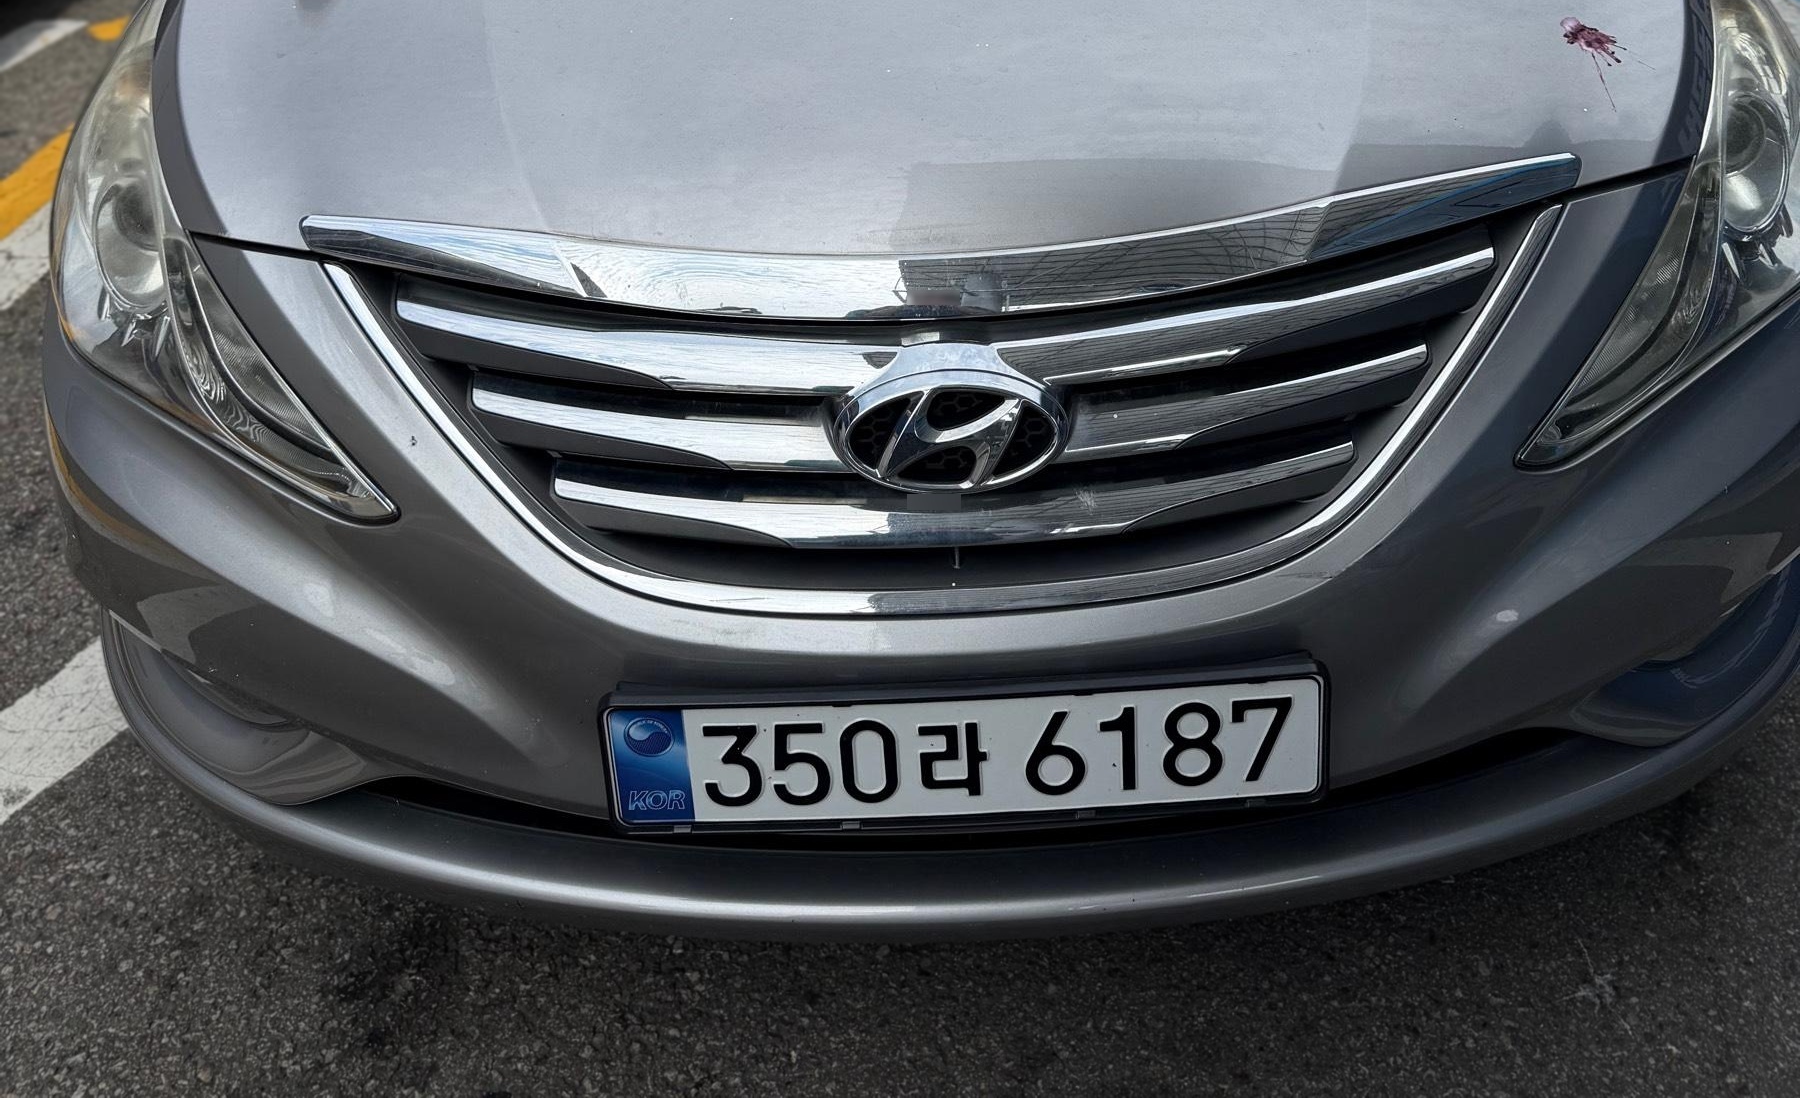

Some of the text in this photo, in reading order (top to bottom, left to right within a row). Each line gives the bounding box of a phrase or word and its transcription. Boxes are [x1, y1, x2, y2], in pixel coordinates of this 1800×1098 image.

[701, 695, 1295, 808] 350라 6187
[628, 789, 686, 811] KOR
